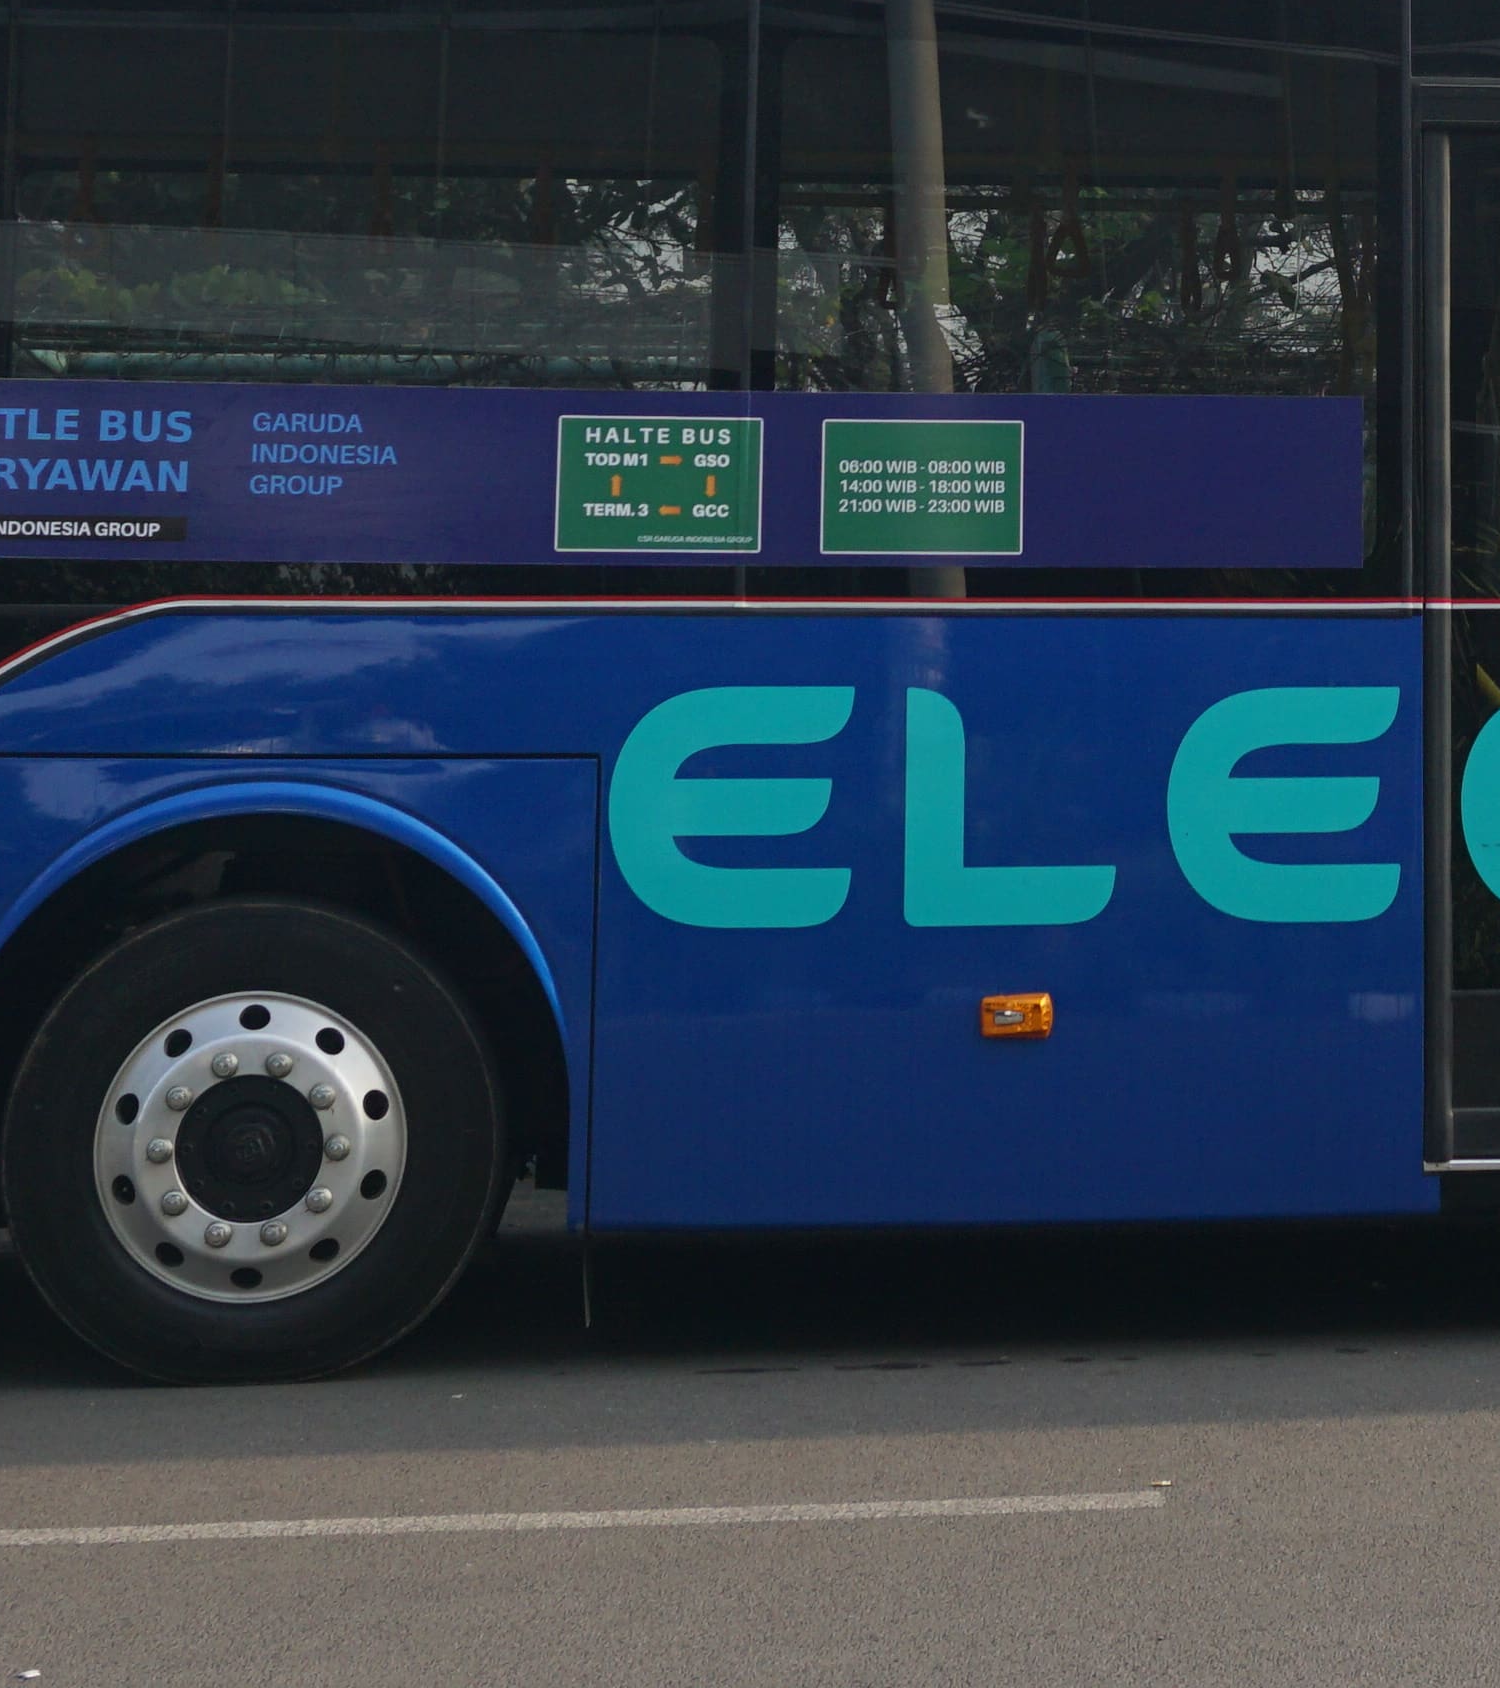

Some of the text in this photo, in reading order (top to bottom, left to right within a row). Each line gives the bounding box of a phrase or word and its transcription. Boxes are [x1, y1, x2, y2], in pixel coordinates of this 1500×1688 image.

[100, 410, 193, 443] BUS
[252, 412, 364, 433] GARUDA
[585, 426, 732, 445] HALTE BUS
[251, 443, 398, 465] INDONESIA
[584, 452, 649, 467] TOD M1
[693, 454, 730, 468] GSO
[839, 459, 883, 474] 06:00
[886, 460, 917, 474] WIB
[927, 460, 972, 475] 08:00
[974, 461, 1006, 474] WIB
[250, 474, 343, 495] GROUP
[840, 479, 883, 494] 14:00
[886, 480, 917, 494] WIB
[928, 479, 972, 494] 18:00
[974, 480, 1006, 494] WIB
[582, 503, 649, 518] TERM. 3
[692, 504, 729, 518] GCC
[838, 499, 883, 513] 21:00
[886, 499, 917, 513] WIB
[927, 499, 971, 513] 23:00
[974, 499, 1006, 513] WIB
[94, 521, 161, 538] GROUP
